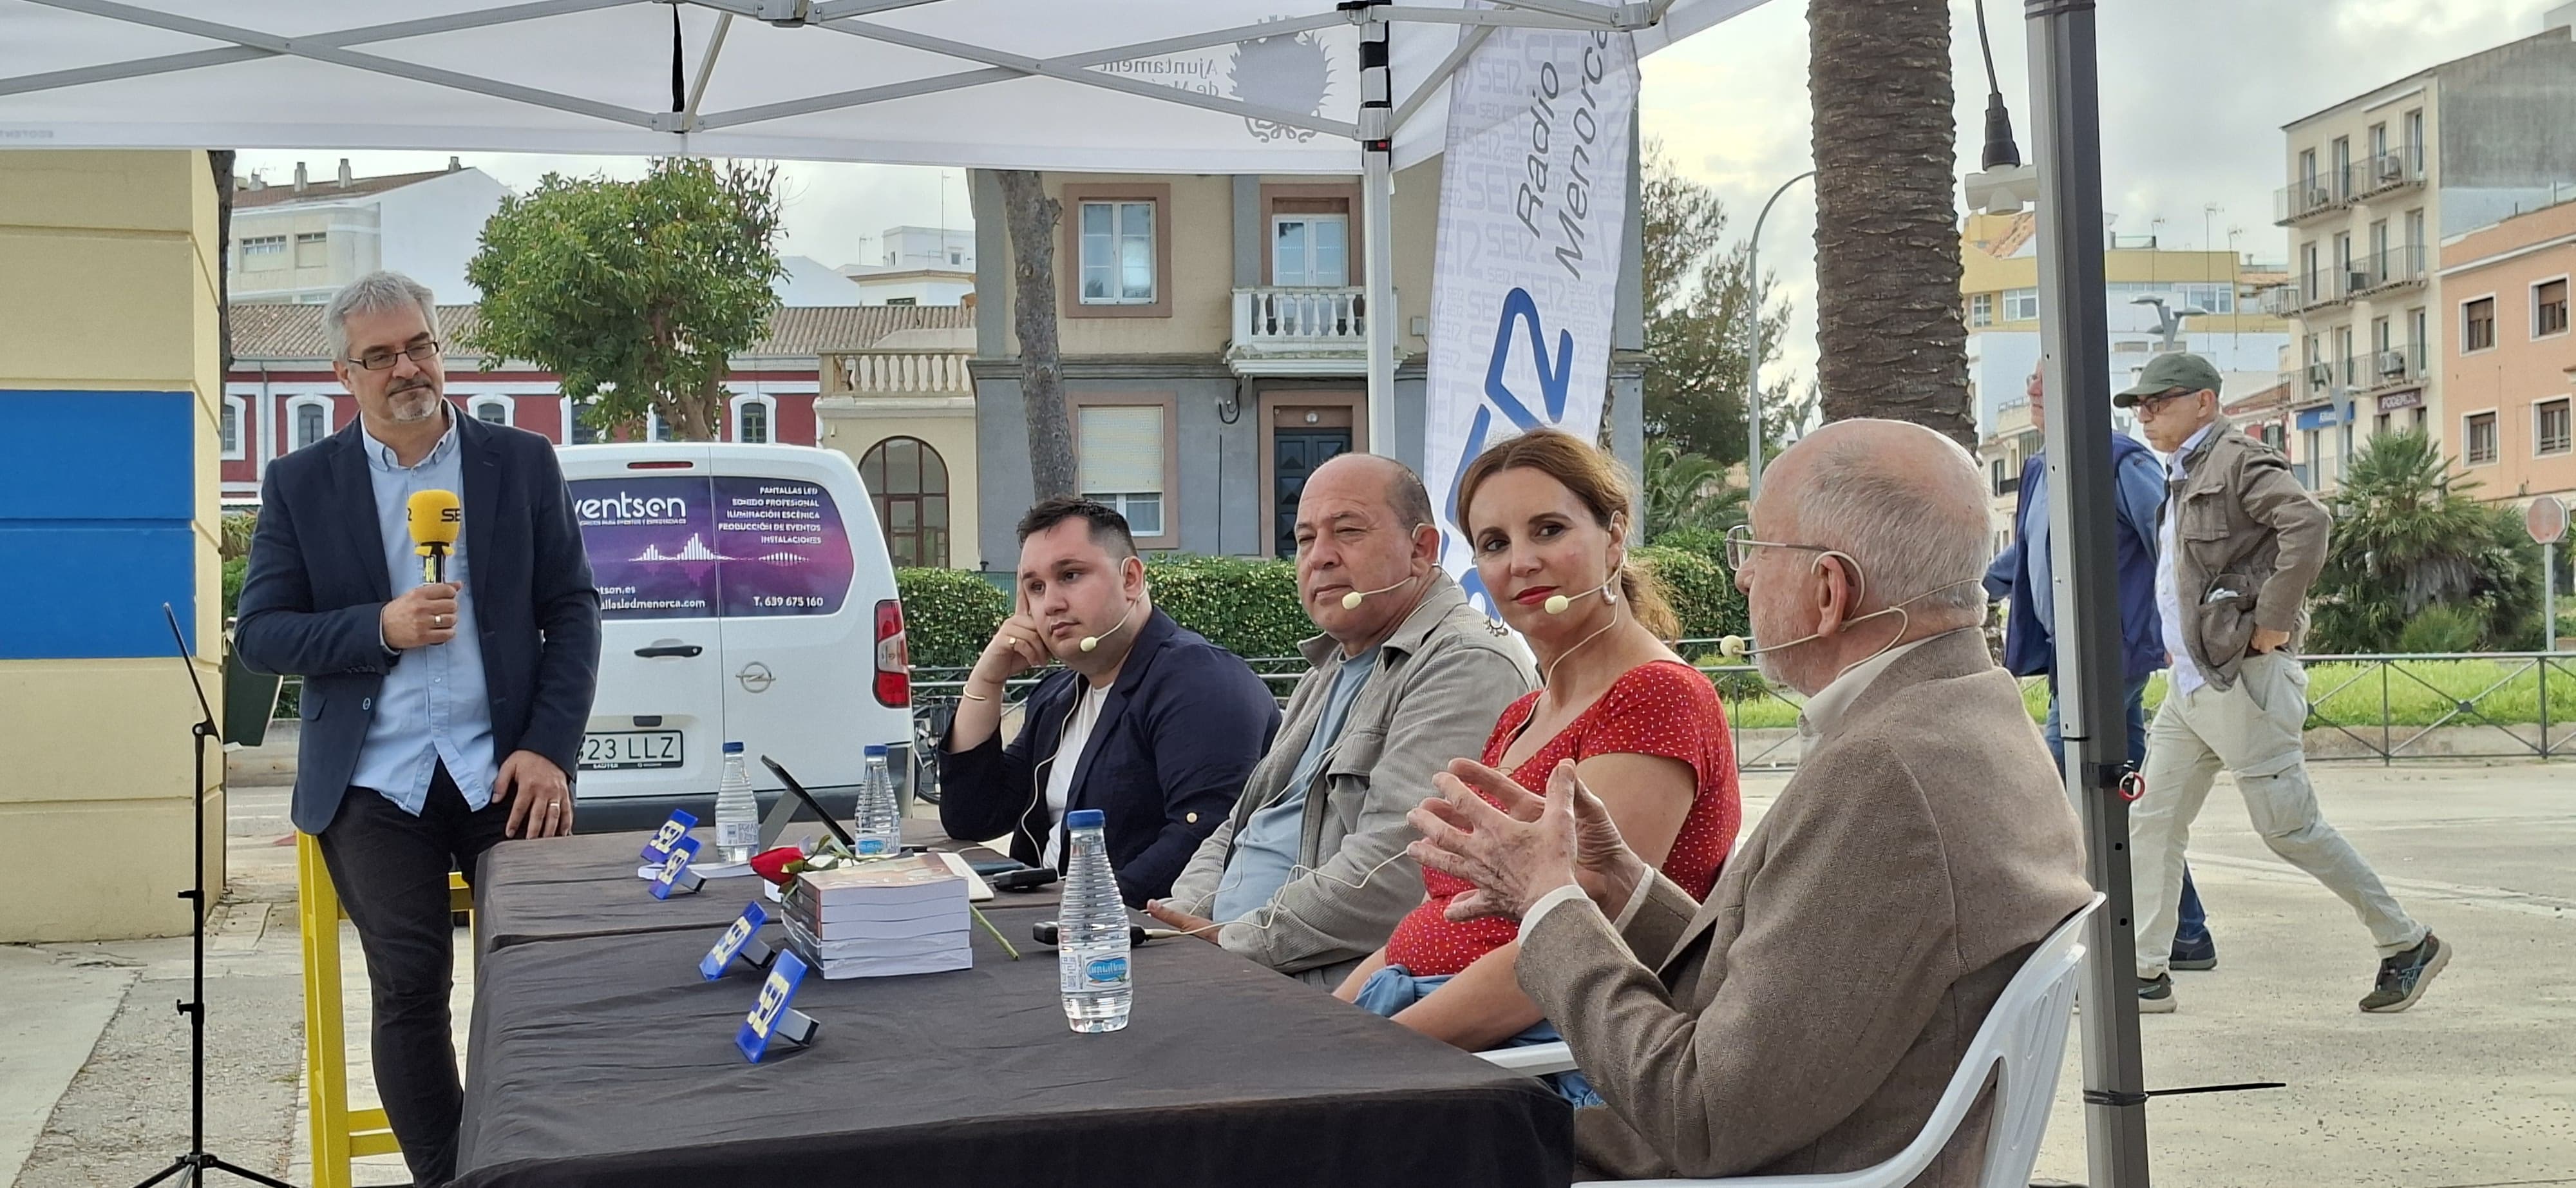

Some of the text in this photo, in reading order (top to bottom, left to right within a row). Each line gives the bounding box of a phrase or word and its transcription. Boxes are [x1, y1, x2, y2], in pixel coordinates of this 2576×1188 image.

[1516, 61, 1559, 240] Radio
[760, 486, 819, 495] PANTALLAS LED
[766, 499, 820, 507] PROFESIONAL
[718, 522, 821, 532] PRODUCCIÓN DE EVENTOS
[761, 535, 822, 544] INSTALACIONES
[753, 596, 763, 607] T.
[786, 597, 804, 607] 675
[806, 597, 824, 607] 160
[579, 736, 674, 760] 23 LLZ
